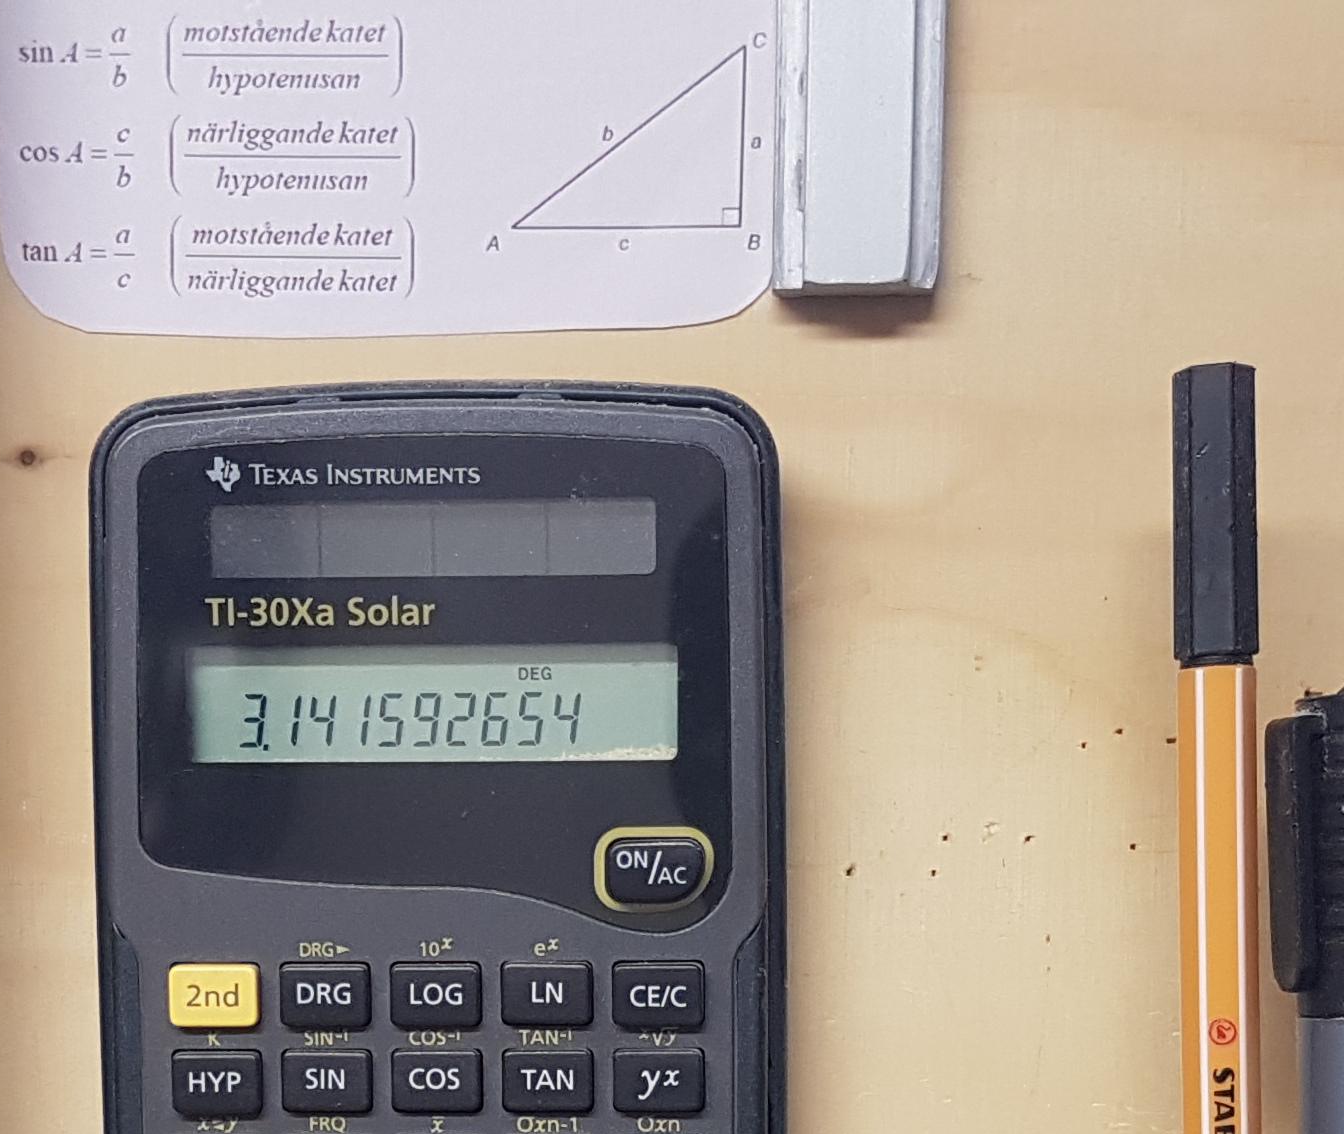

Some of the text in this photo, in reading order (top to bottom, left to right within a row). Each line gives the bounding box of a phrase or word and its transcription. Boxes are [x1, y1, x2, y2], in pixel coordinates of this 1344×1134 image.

[112, 27, 127, 42] a
[184, 20, 385, 43] motstående katet
[752, 32, 767, 49] C
[19, 40, 54, 63] sin
[60, 43, 79, 63] A
[112, 65, 127, 88] b
[208, 66, 360, 96] hypotenusan
[117, 127, 130, 143] c
[187, 124, 399, 151] närliggande katet
[602, 126, 614, 141] b
[751, 137, 761, 149] a
[20, 145, 59, 163] cos
[65, 141, 83, 163] A
[117, 165, 131, 188] b
[216, 167, 368, 196] hypotenusan
[116, 229, 130, 244] a
[192, 221, 393, 246] motstående katet
[486, 236, 500, 251] A
[619, 239, 629, 250] c
[748, 234, 761, 250] B
[22, 243, 56, 262] tan
[65, 243, 83, 262] A
[117, 273, 131, 288] c
[188, 269, 398, 298] närliggande katet
[248, 463, 481, 486] TEXAS INSTRUMENTS
[205, 596, 435, 627] TI-30Xa Solar
[517, 666, 553, 682] DEG
[238, 692, 583, 753] 3.141592654
[299, 942, 335, 958] DRG
[186, 984, 239, 1008] 2nd
[296, 983, 352, 1006] DRG
[409, 983, 464, 1006] LOG
[530, 982, 564, 1004] LN
[629, 985, 688, 1010] CE/C
[188, 1071, 242, 1094] HYP
[305, 1068, 346, 1091] SIN
[408, 1068, 460, 1091] COS
[521, 1068, 575, 1091] TAN
[309, 1117, 346, 1133] FRQ
